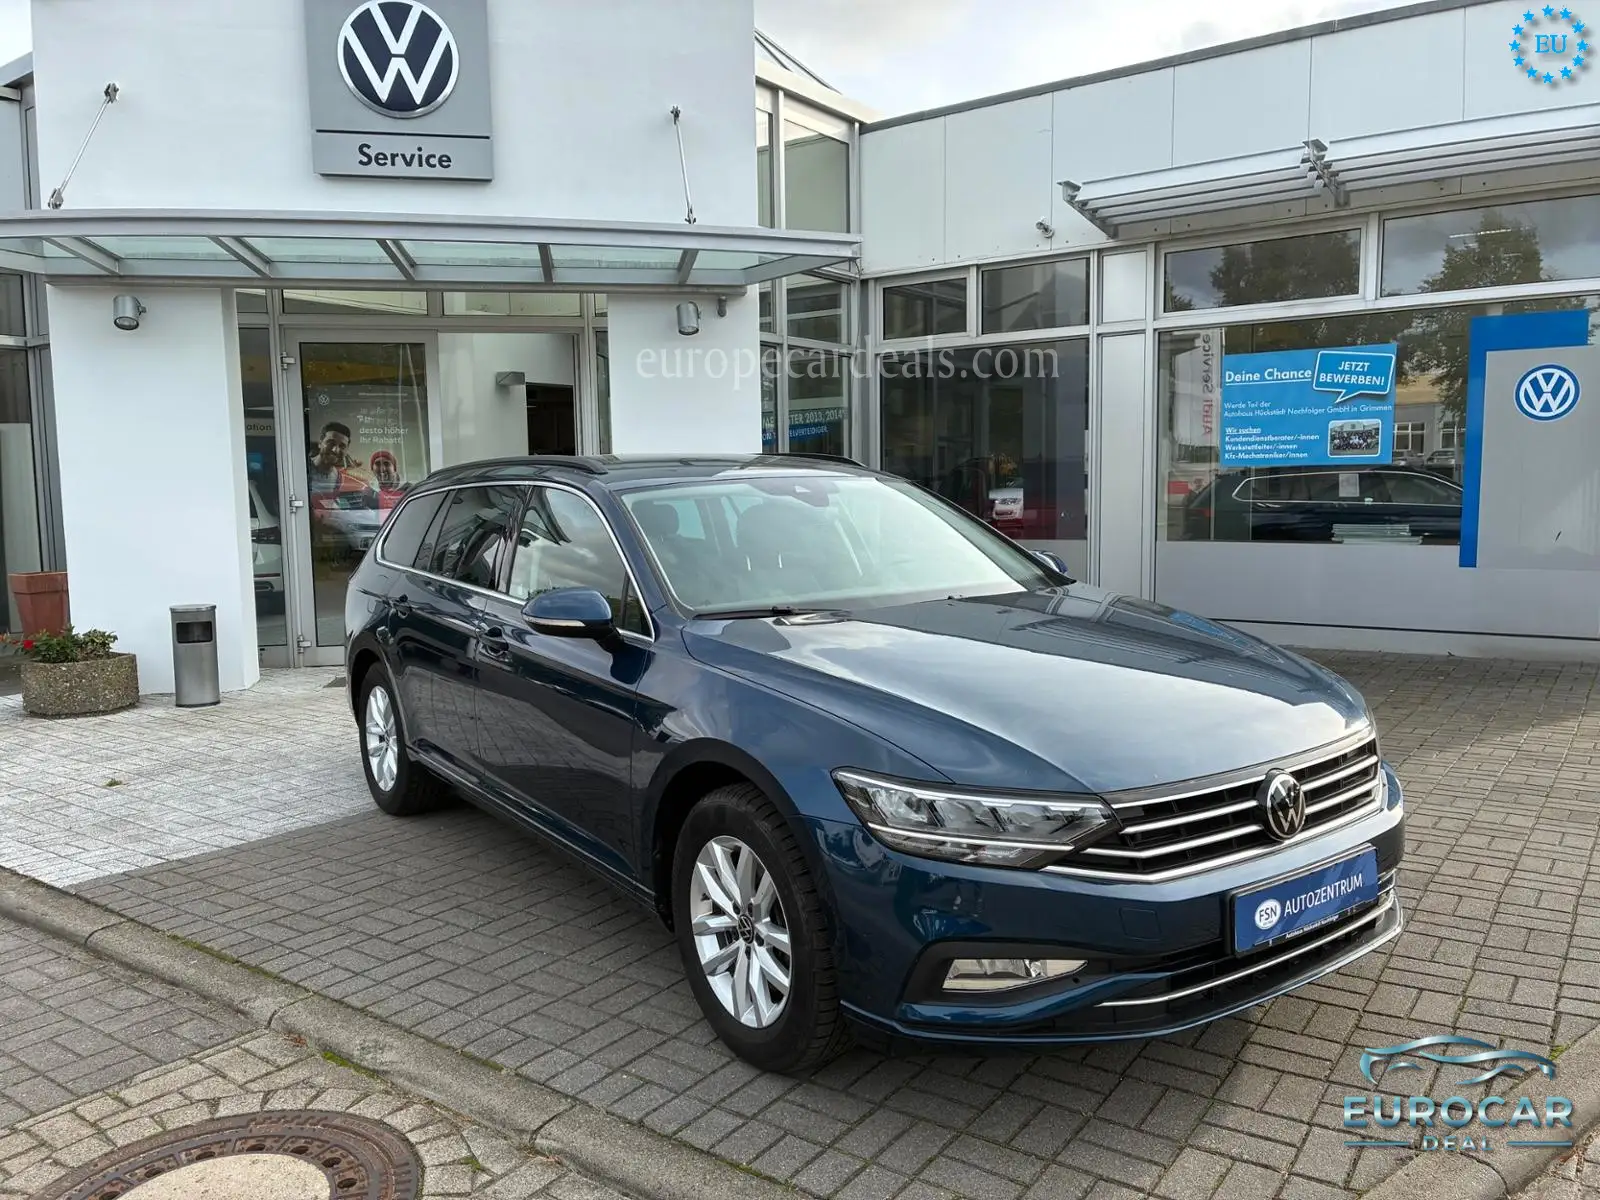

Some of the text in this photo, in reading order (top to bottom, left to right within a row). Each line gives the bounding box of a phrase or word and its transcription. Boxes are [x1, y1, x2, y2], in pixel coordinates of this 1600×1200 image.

[338, 0, 459, 119] VW
[358, 143, 452, 169] Service
[1338, 361, 1370, 372] JETZT
[1225, 367, 1312, 382] Deine Chance
[1319, 373, 1385, 386] BEWERBEN!
[1514, 363, 1581, 422] VW
[1259, 400, 1271, 408] der
[1326, 405, 1350, 413] GmbH
[1259, 873, 1363, 922] FSN AUTOZENTRUM
